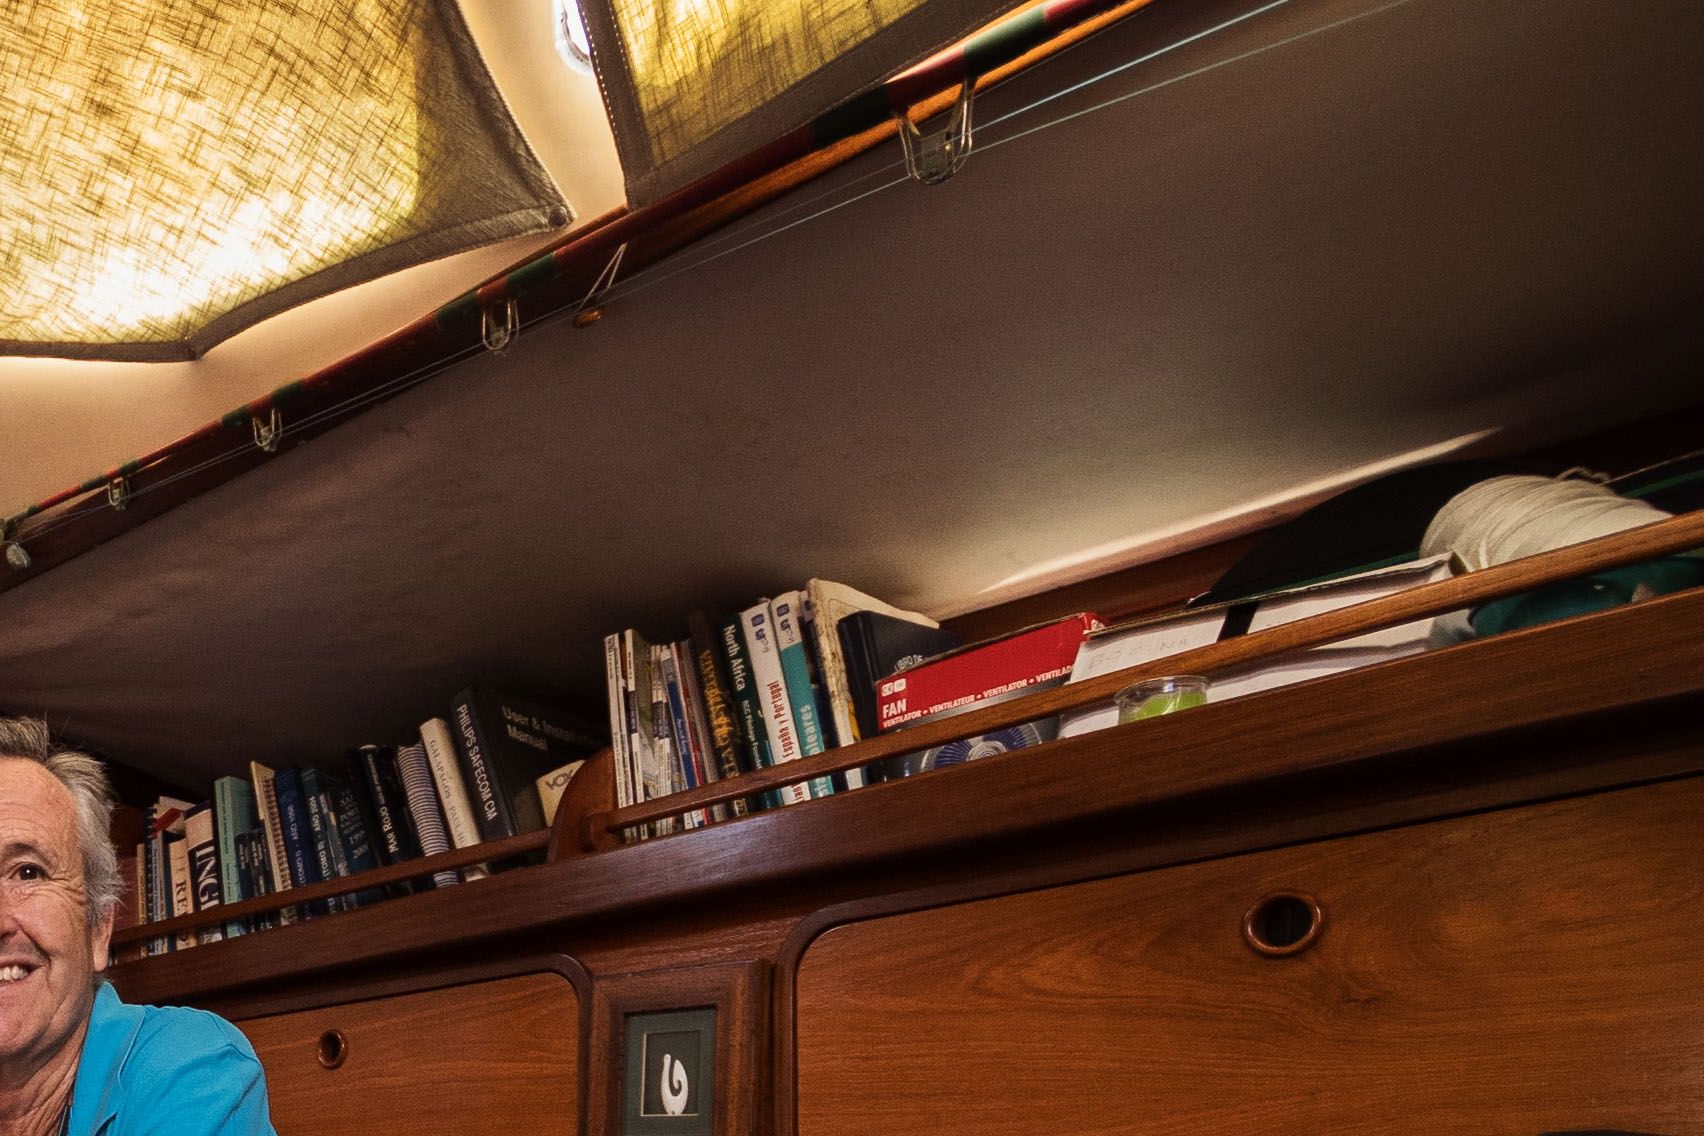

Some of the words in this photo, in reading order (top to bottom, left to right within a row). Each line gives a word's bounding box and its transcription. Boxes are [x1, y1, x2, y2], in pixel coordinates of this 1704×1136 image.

[722, 624, 743, 660] North
[730, 658, 747, 692] Africa
[983, 678, 1028, 698] VENTILATOR
[1035, 665, 1073, 683] VENTILAD
[766, 679, 785, 721] Portugal
[882, 698, 907, 719] FAN
[800, 703, 825, 756] aleares
[456, 703, 477, 748] PHILIPS
[468, 746, 493, 802] SAFECOM
[483, 799, 499, 821] CM
